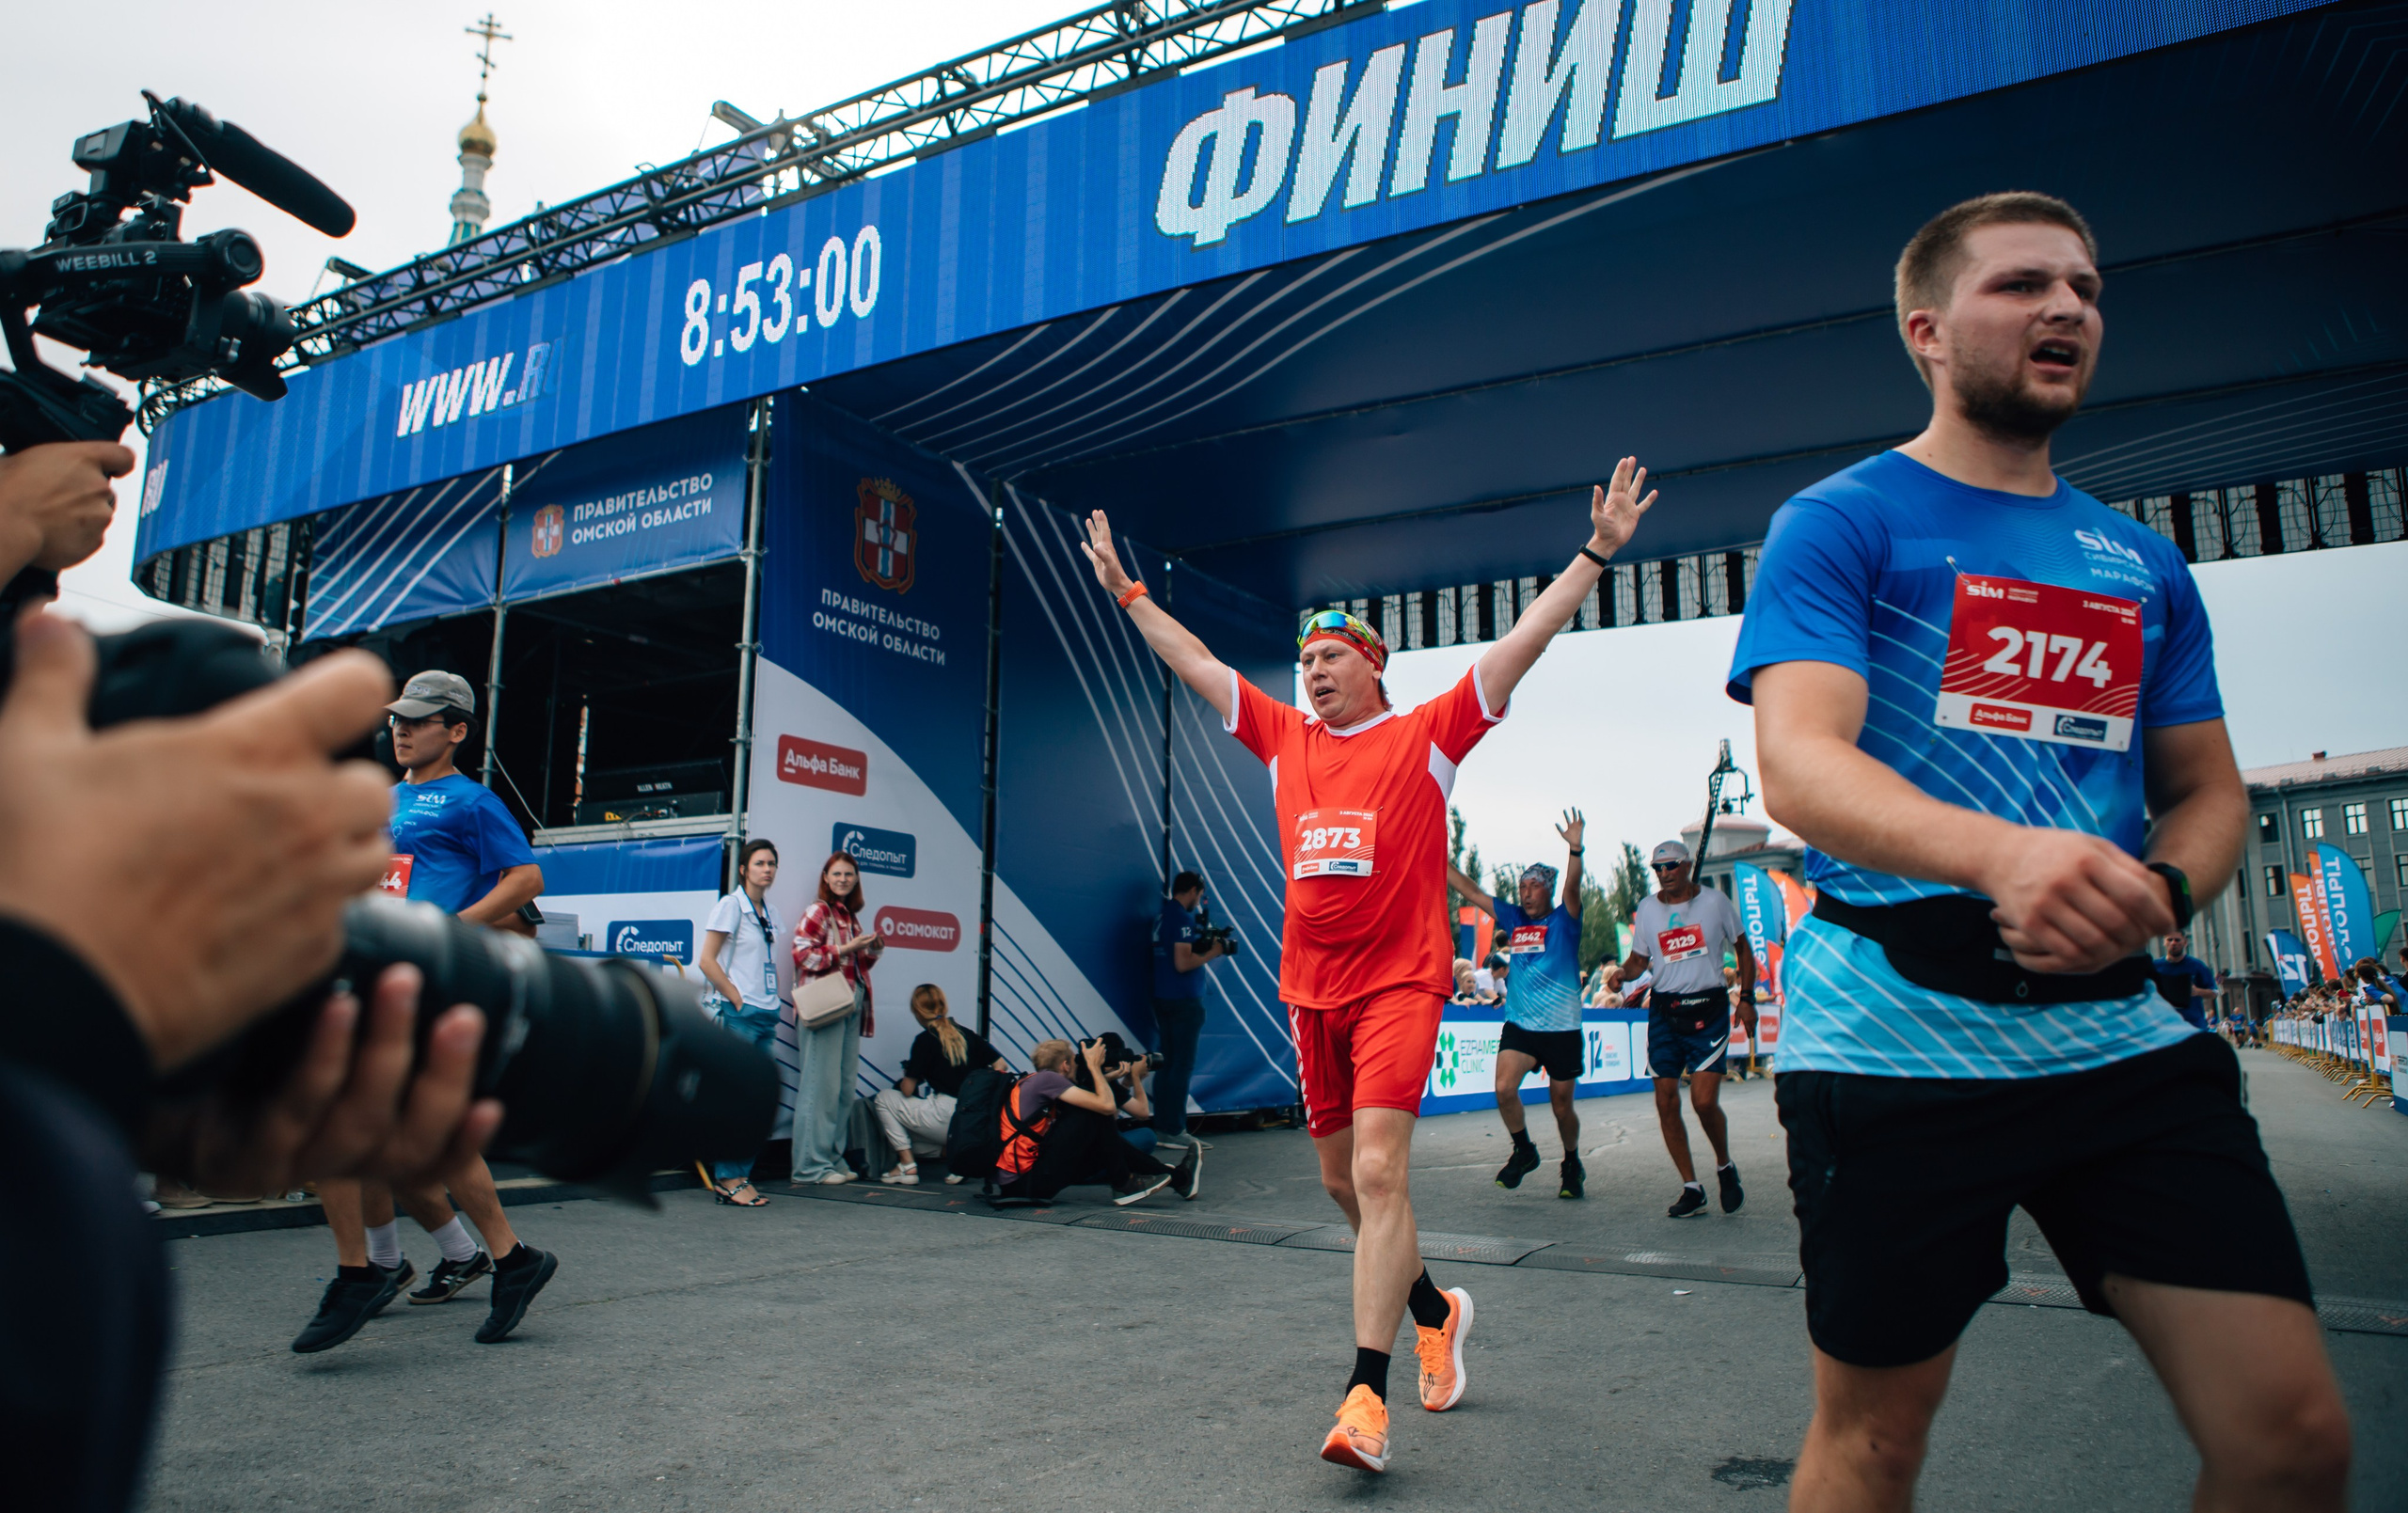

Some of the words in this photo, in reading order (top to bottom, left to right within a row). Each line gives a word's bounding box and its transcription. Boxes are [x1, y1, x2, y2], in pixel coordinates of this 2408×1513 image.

[1155, 0, 1792, 247] ФИНИШ
[55, 252, 140, 273] WEEBILL
[144, 250, 158, 264] 2
[680, 225, 881, 366] 8:53:00
[574, 472, 713, 523] ПРАВИТЕЛЬСТВО
[572, 512, 636, 544] ОМСКОЙ
[642, 496, 712, 529] ОБЛАСТИ
[821, 588, 940, 640] ПРАВИТЕЛЬСТВО
[813, 611, 879, 646] ОМСКОЙ
[882, 633, 945, 666] ОБЛАСТИ
[1983, 625, 2113, 688] 2174
[784, 748, 828, 775] Альфа
[829, 756, 861, 780] Банк
[849, 843, 908, 864] Следопыт
[1301, 827, 1361, 852] 2873
[896, 922, 956, 940] самокат
[1514, 931, 1542, 943] 2642
[1666, 934, 1697, 951] 2129
[624, 938, 684, 954] Следопыт
[1461, 1058, 1485, 1074] CLINIC
